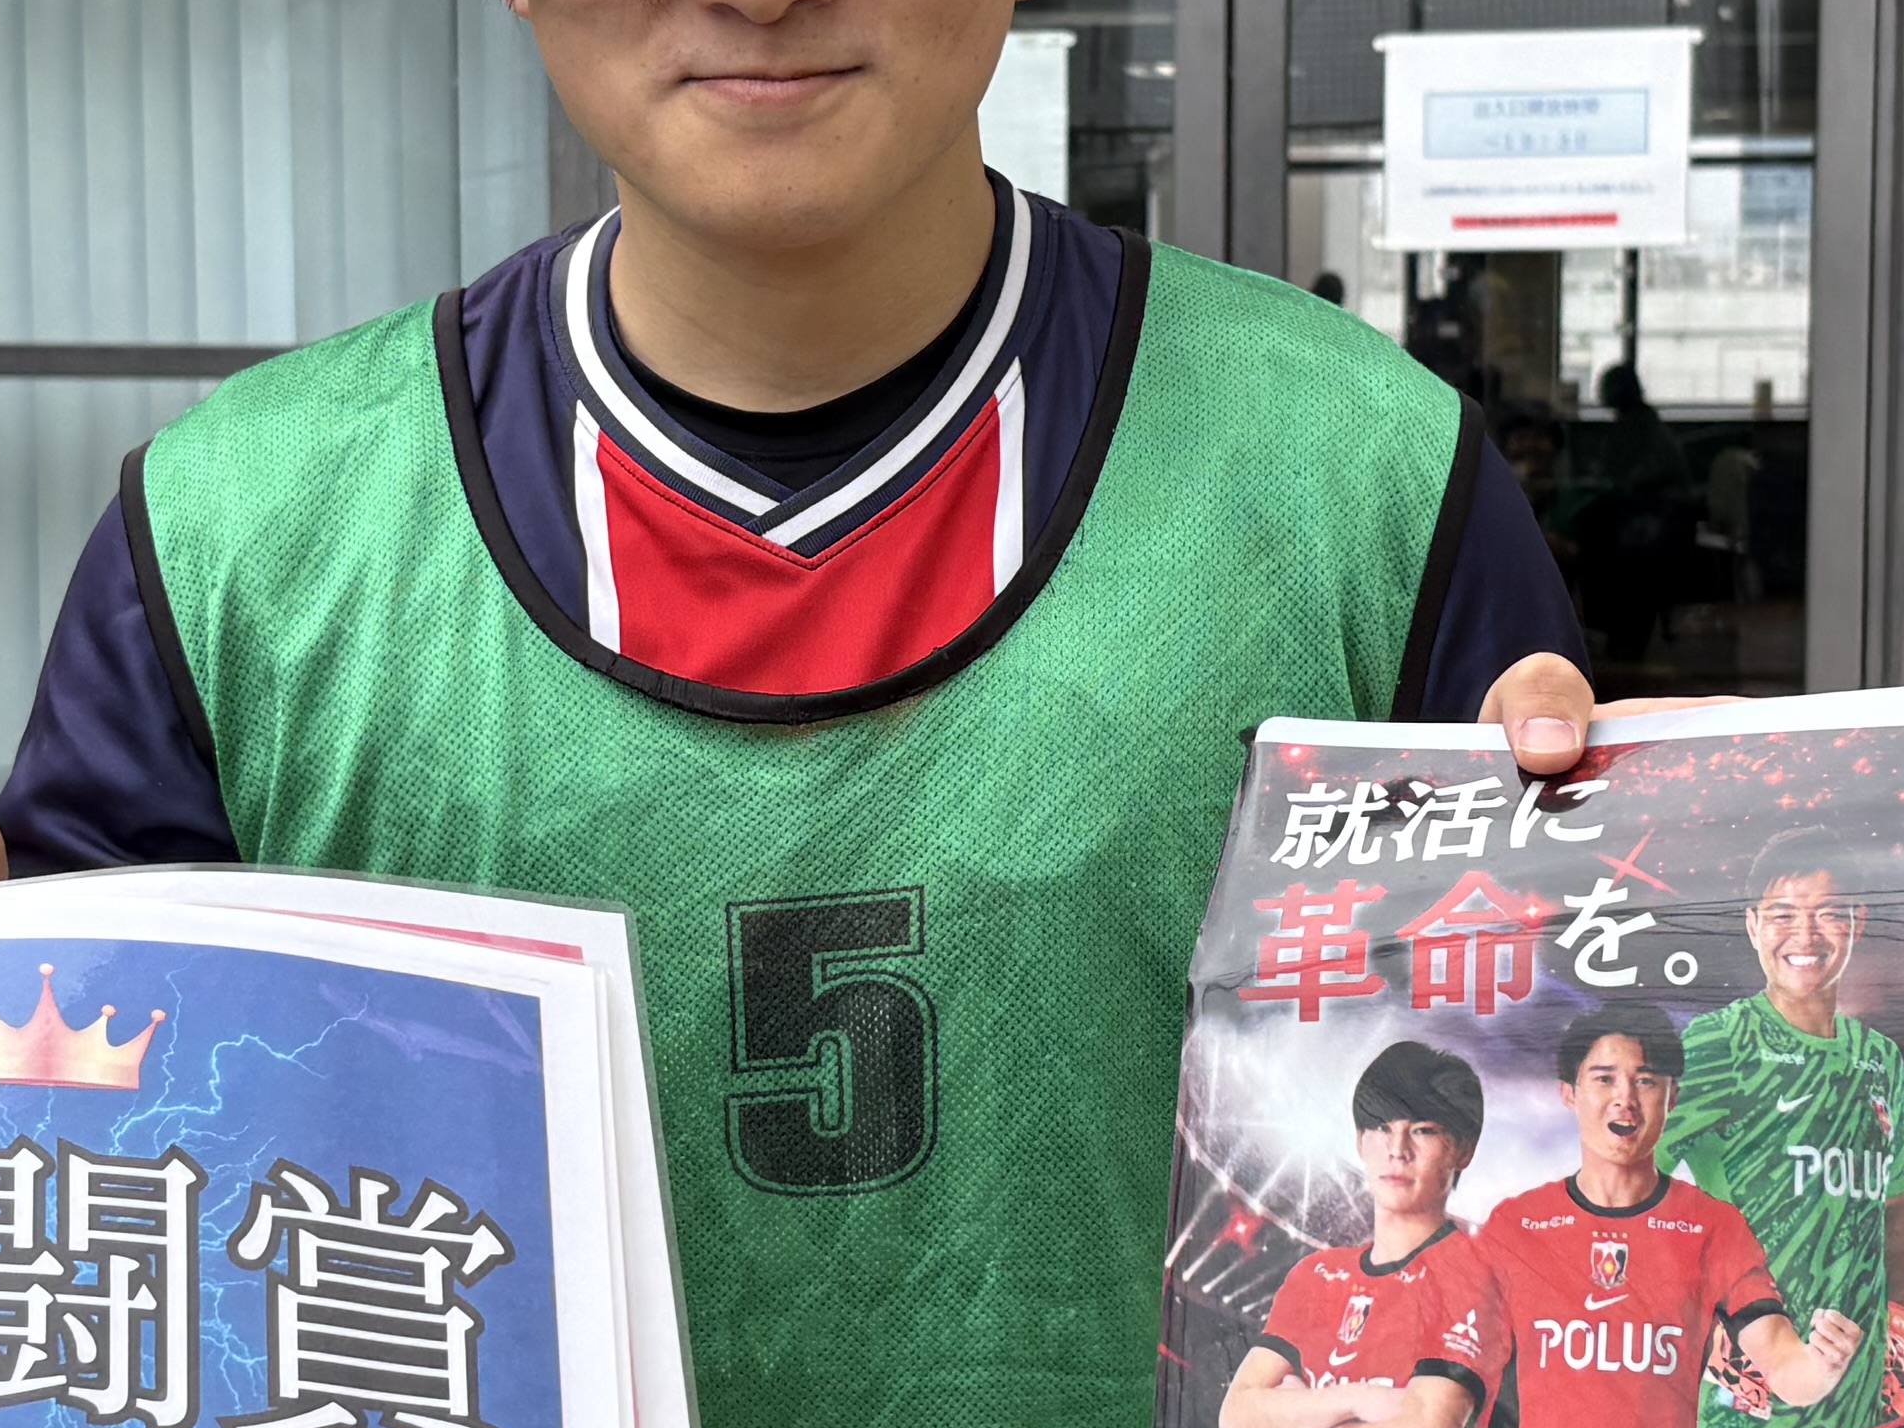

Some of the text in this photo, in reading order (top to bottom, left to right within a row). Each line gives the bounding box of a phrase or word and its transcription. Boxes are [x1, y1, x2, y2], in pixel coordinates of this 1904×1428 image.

[1269, 775, 1609, 869] 就活に
[1238, 871, 1698, 1023] 革命を。
[725, 885, 938, 1197] 5
[1533, 1319, 1683, 1375] POLUS
